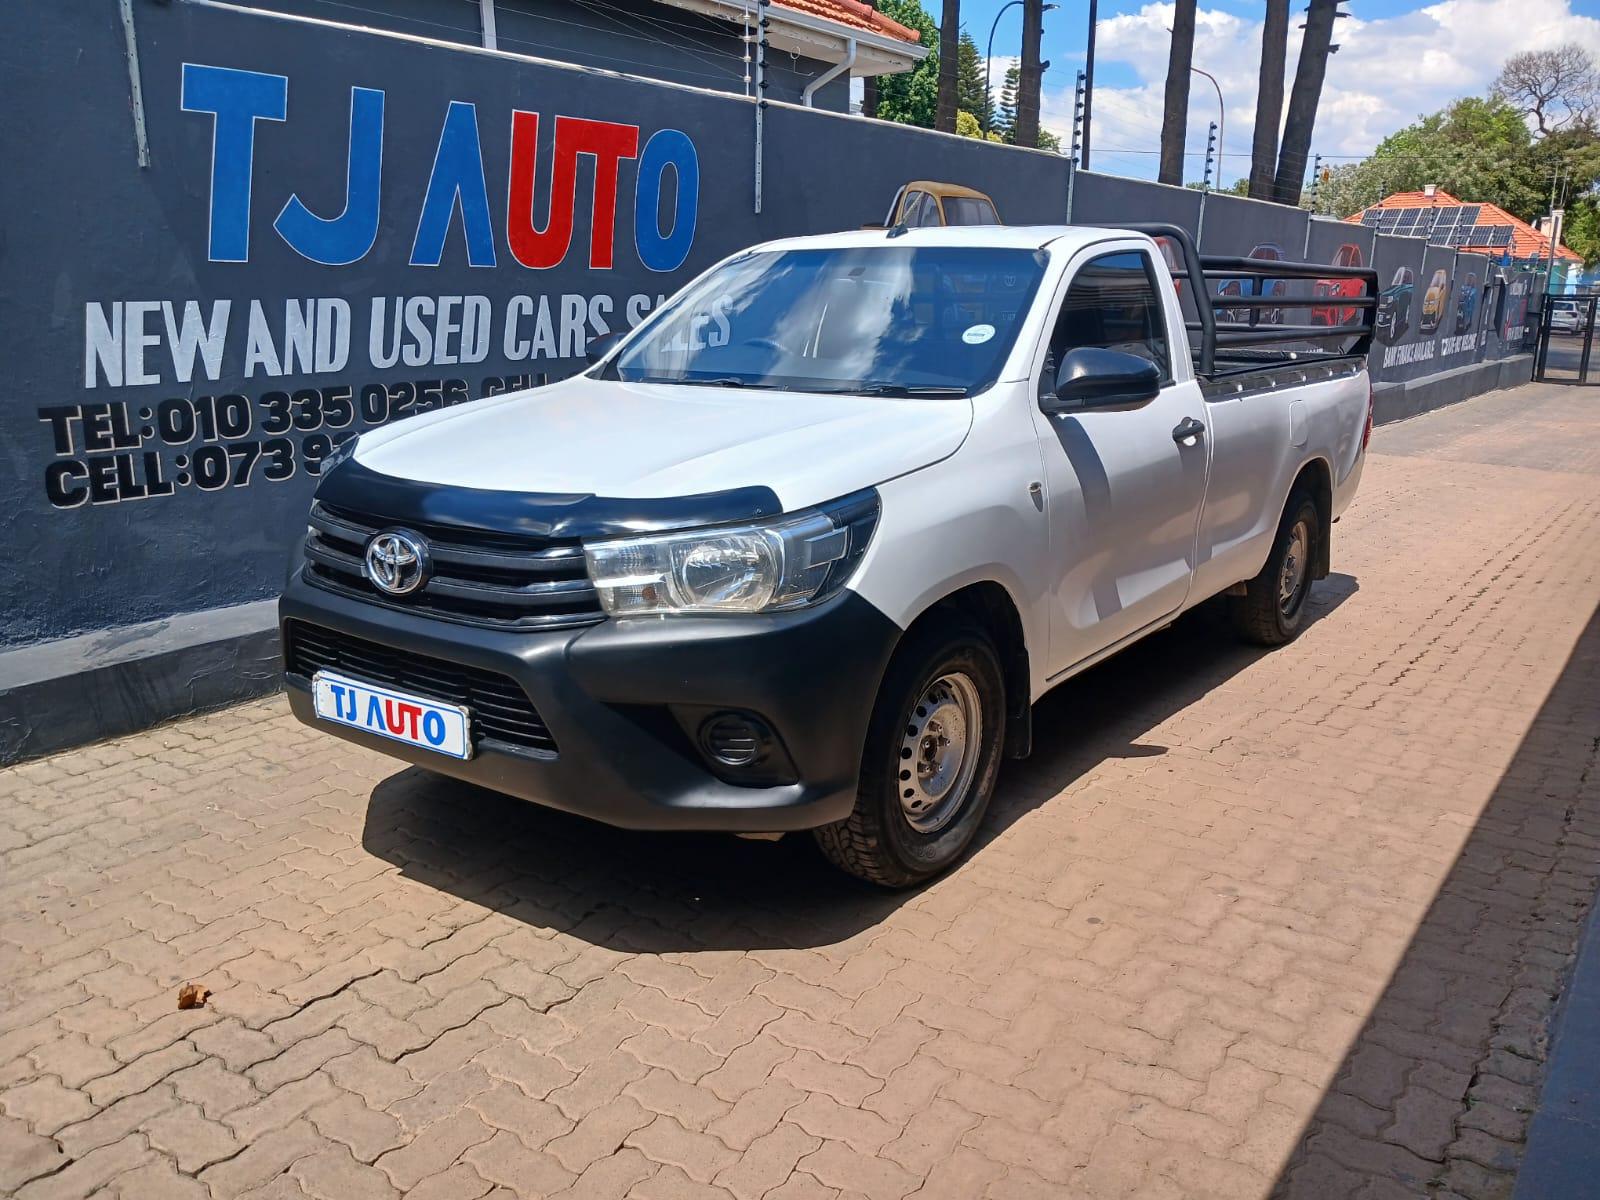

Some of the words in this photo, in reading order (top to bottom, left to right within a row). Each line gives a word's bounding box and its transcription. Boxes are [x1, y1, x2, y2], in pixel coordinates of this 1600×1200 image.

[180, 62, 386, 266] TJ
[408, 100, 700, 273] AUTO
[85, 299, 232, 389] NEW
[244, 297, 352, 379] AND
[369, 295, 491, 369] USED
[503, 293, 613, 361] CARS
[626, 293, 731, 352] SLES
[259, 386, 354, 434] 335
[361, 379, 469, 424] 0256
[331, 684, 357, 722] TJ
[366, 697, 446, 746] AUTO
